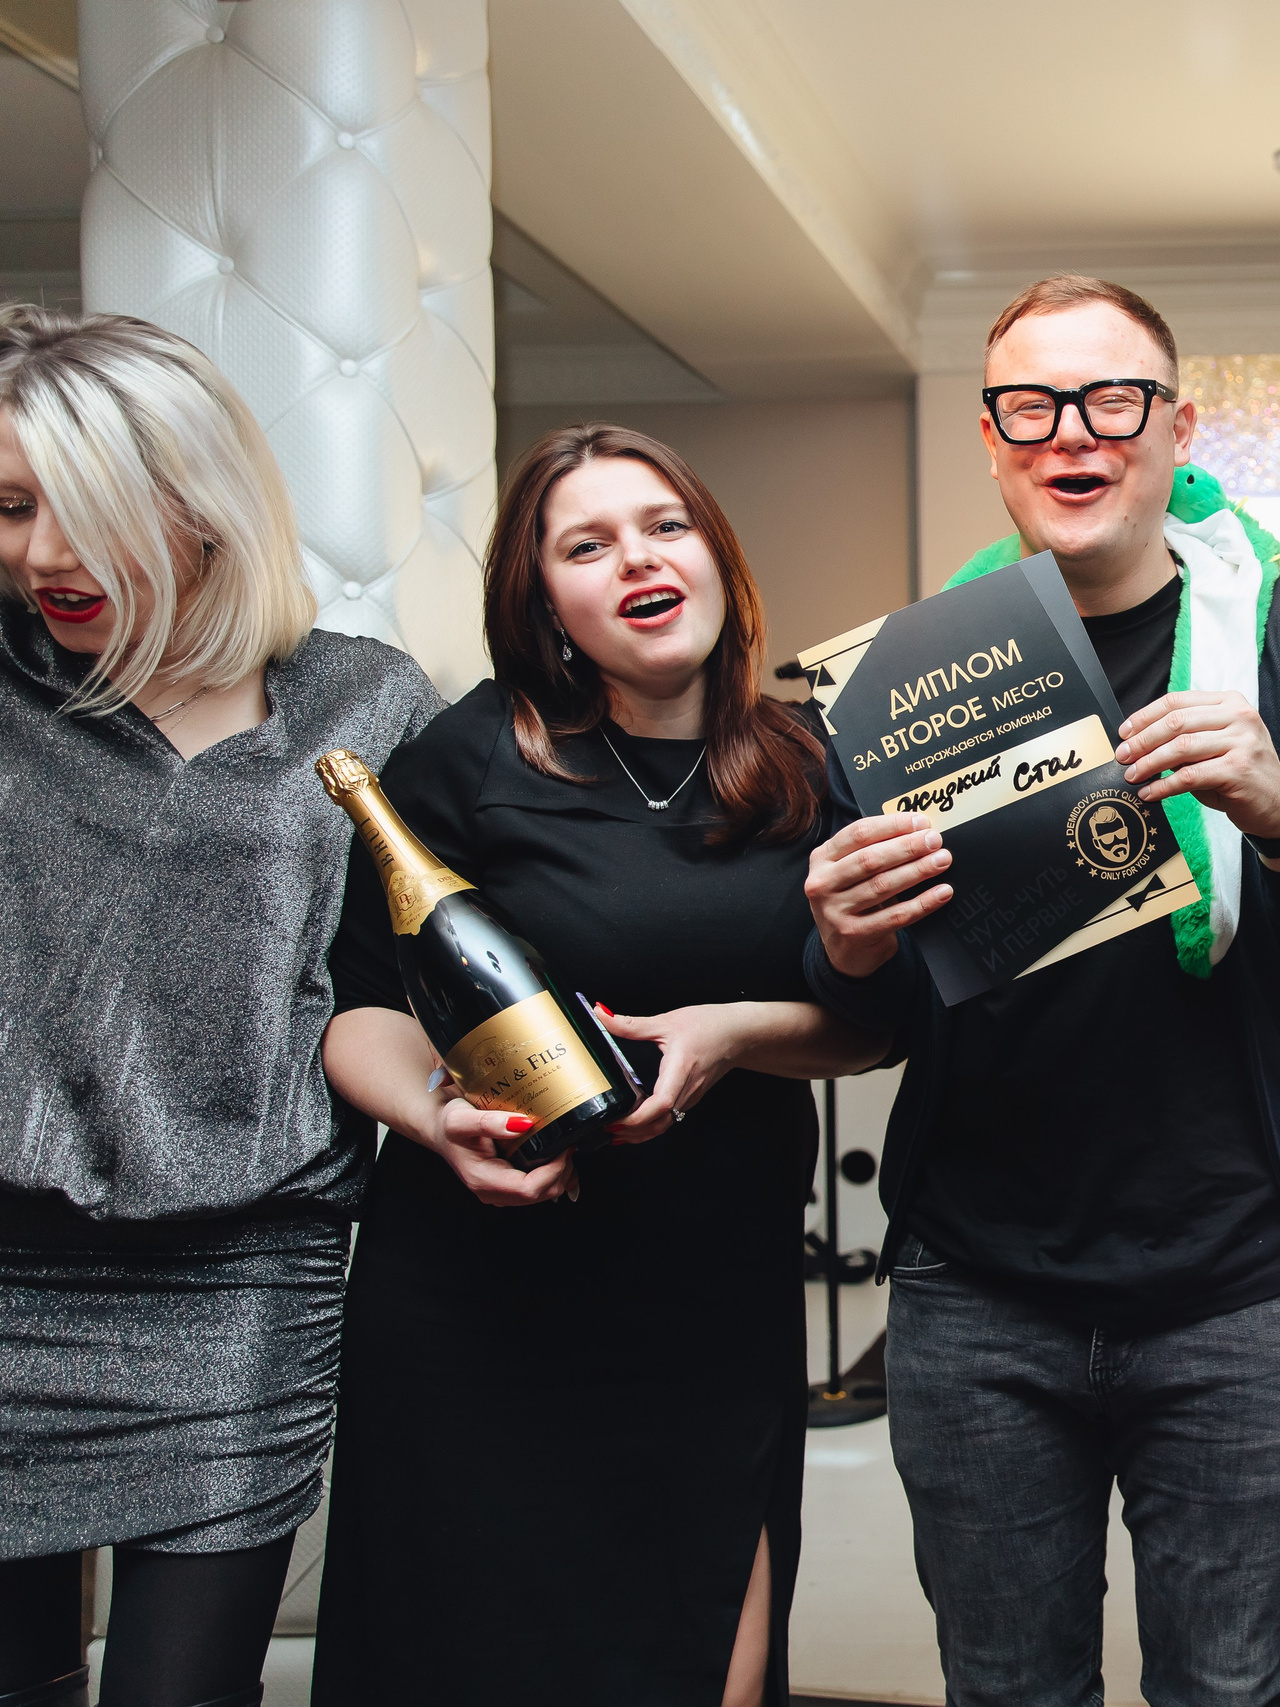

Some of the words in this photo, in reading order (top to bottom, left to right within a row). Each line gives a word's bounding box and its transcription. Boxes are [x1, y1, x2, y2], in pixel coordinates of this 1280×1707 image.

[889, 638, 1023, 721] ДИПЛОМ
[852, 750, 881, 771] ЗА
[880, 696, 987, 759] ВТОРОЕ
[991, 671, 1064, 712] МЕСТО
[904, 730, 995, 775] награждается
[996, 705, 1053, 736] команда
[359, 816, 395, 868] BRUT
[1066, 796, 1089, 836] DEMIDOV
[1090, 788, 1120, 800] PARTY
[1121, 791, 1143, 808] QUIZ
[1101, 871, 1120, 880] ONLY
[1122, 866, 1138, 878] FOR
[1135, 853, 1150, 869] YOU
[963, 866, 1068, 947] ЧУТЬ-ЧУТЬ
[981, 950, 1005, 973] И
[1002, 887, 1084, 956] ПЕРВЫЕ
[475, 1076, 511, 1110] EJEAN
[513, 1068, 528, 1081] &
[526, 1043, 567, 1071] FILS
[503, 1065, 562, 1103] TRADITIONNELLE
[524, 1107, 533, 1116] UT
